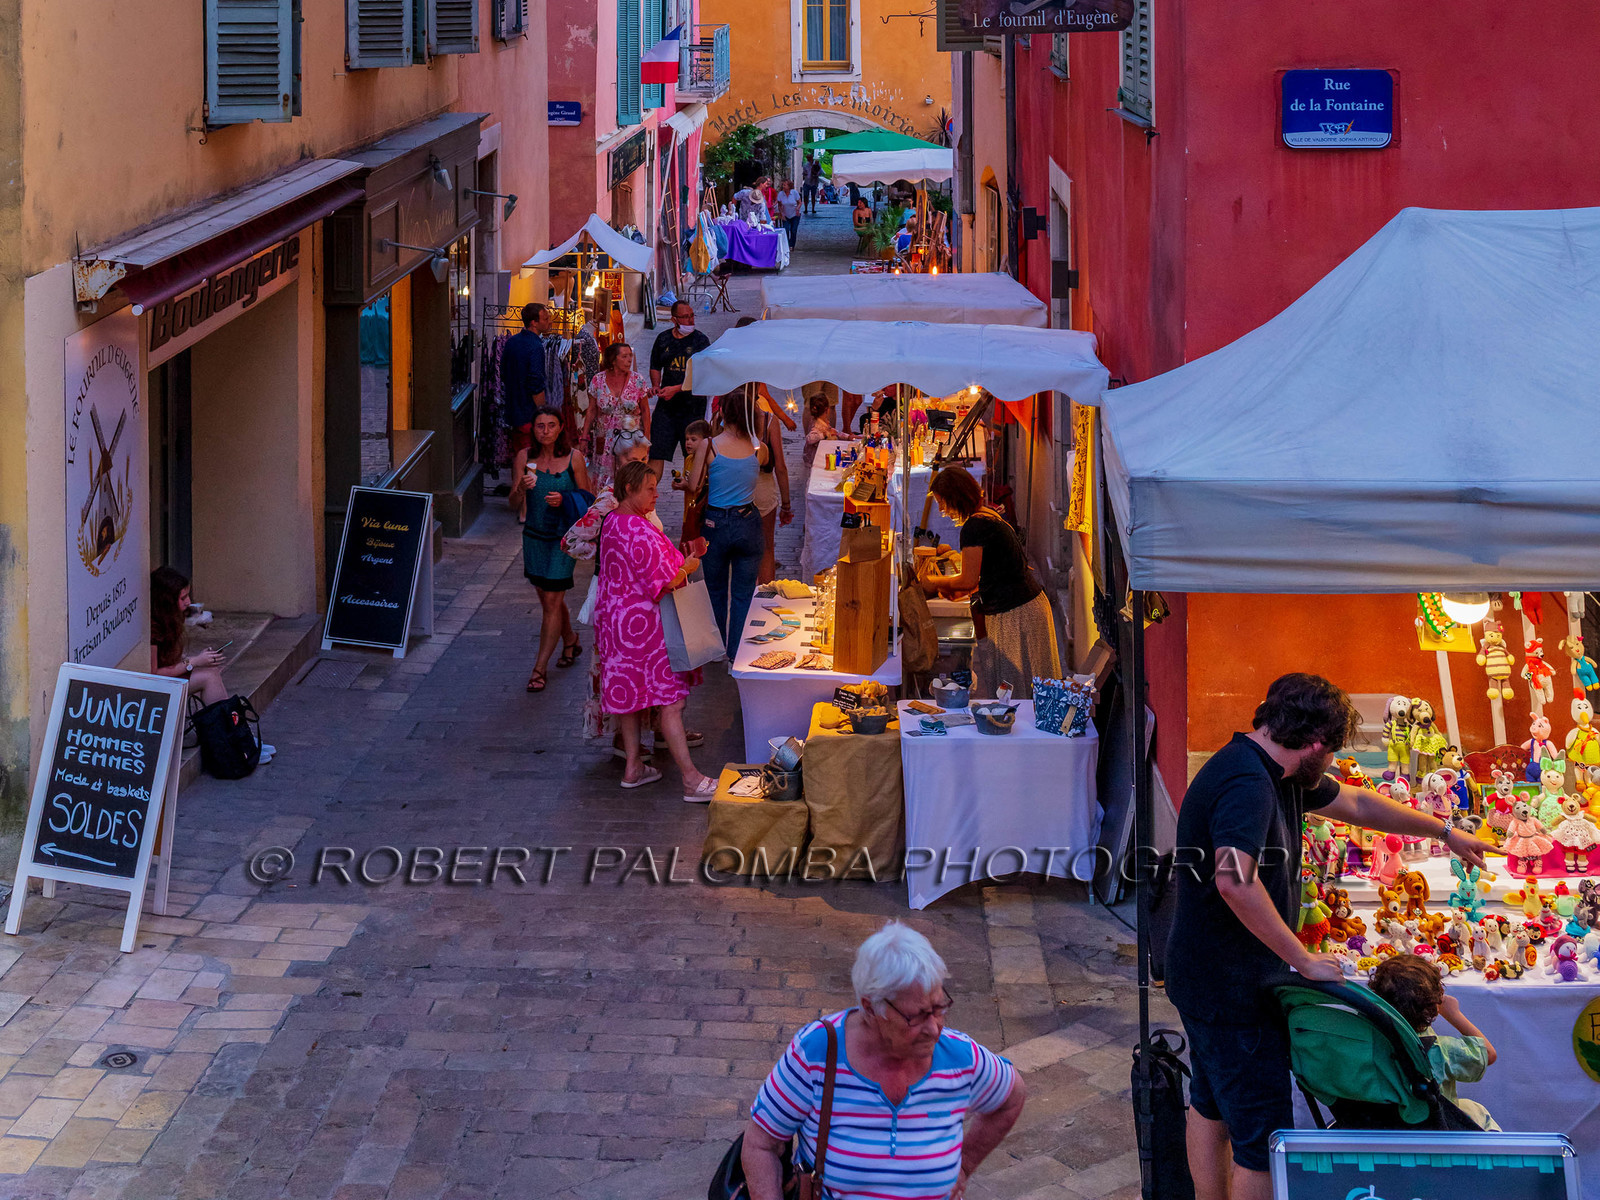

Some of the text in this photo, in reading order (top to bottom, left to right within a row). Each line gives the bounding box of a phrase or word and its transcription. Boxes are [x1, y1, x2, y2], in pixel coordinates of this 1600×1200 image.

[973, 9, 1119, 30] Le fournil d'Eugène
[1324, 78, 1351, 91] Rue
[1290, 98, 1385, 111] de la Fontaine
[150, 236, 300, 352] Boulangerie
[72, 347, 107, 430] FOURNIL
[361, 516, 381, 528] Via
[361, 553, 394, 565] Argent
[86, 577, 126, 627] Depuis 1873
[340, 594, 400, 609] Accessoires
[74, 597, 138, 664] Artisan Boulanger
[68, 687, 163, 735] JUNGLE
[66, 729, 145, 758] HOMMES
[64, 746, 146, 775] FEMMES
[54, 768, 150, 801] Mode et baskets
[48, 792, 142, 849] SOLDES
